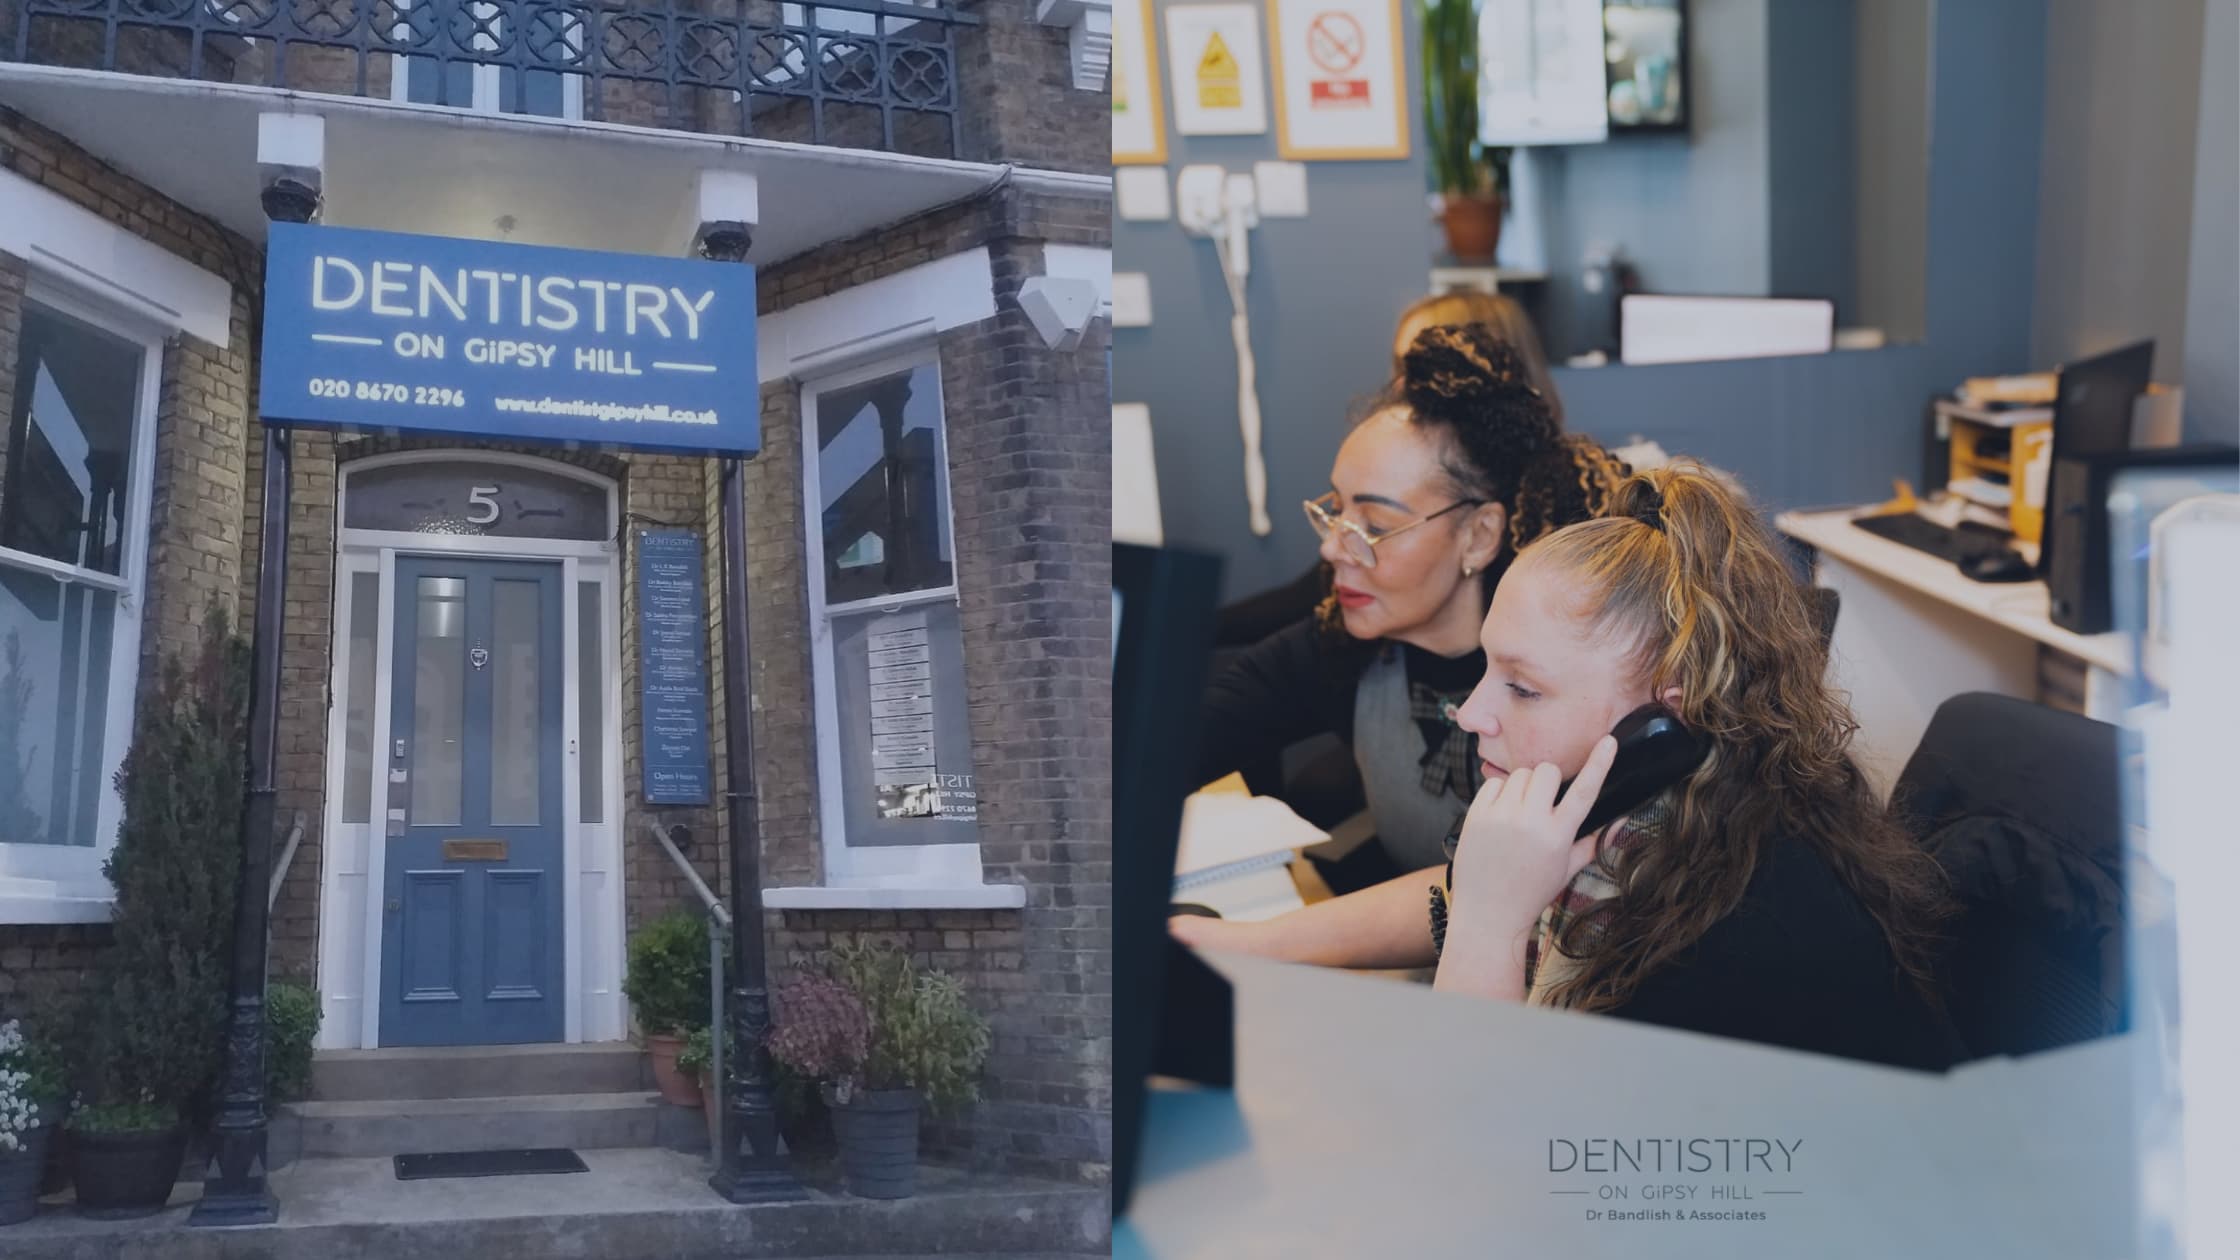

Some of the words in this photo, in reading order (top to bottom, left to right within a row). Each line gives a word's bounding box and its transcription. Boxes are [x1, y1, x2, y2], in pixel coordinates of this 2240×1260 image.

[312, 255, 716, 340] DENTISTRY
[394, 331, 445, 359] ON
[574, 347, 642, 375] HILL
[309, 378, 350, 398] 020
[355, 381, 409, 403] 8670
[414, 386, 465, 408] 2296
[494, 396, 718, 425] www.dentistgipsyhill.co.uk
[466, 487, 499, 523] 5
